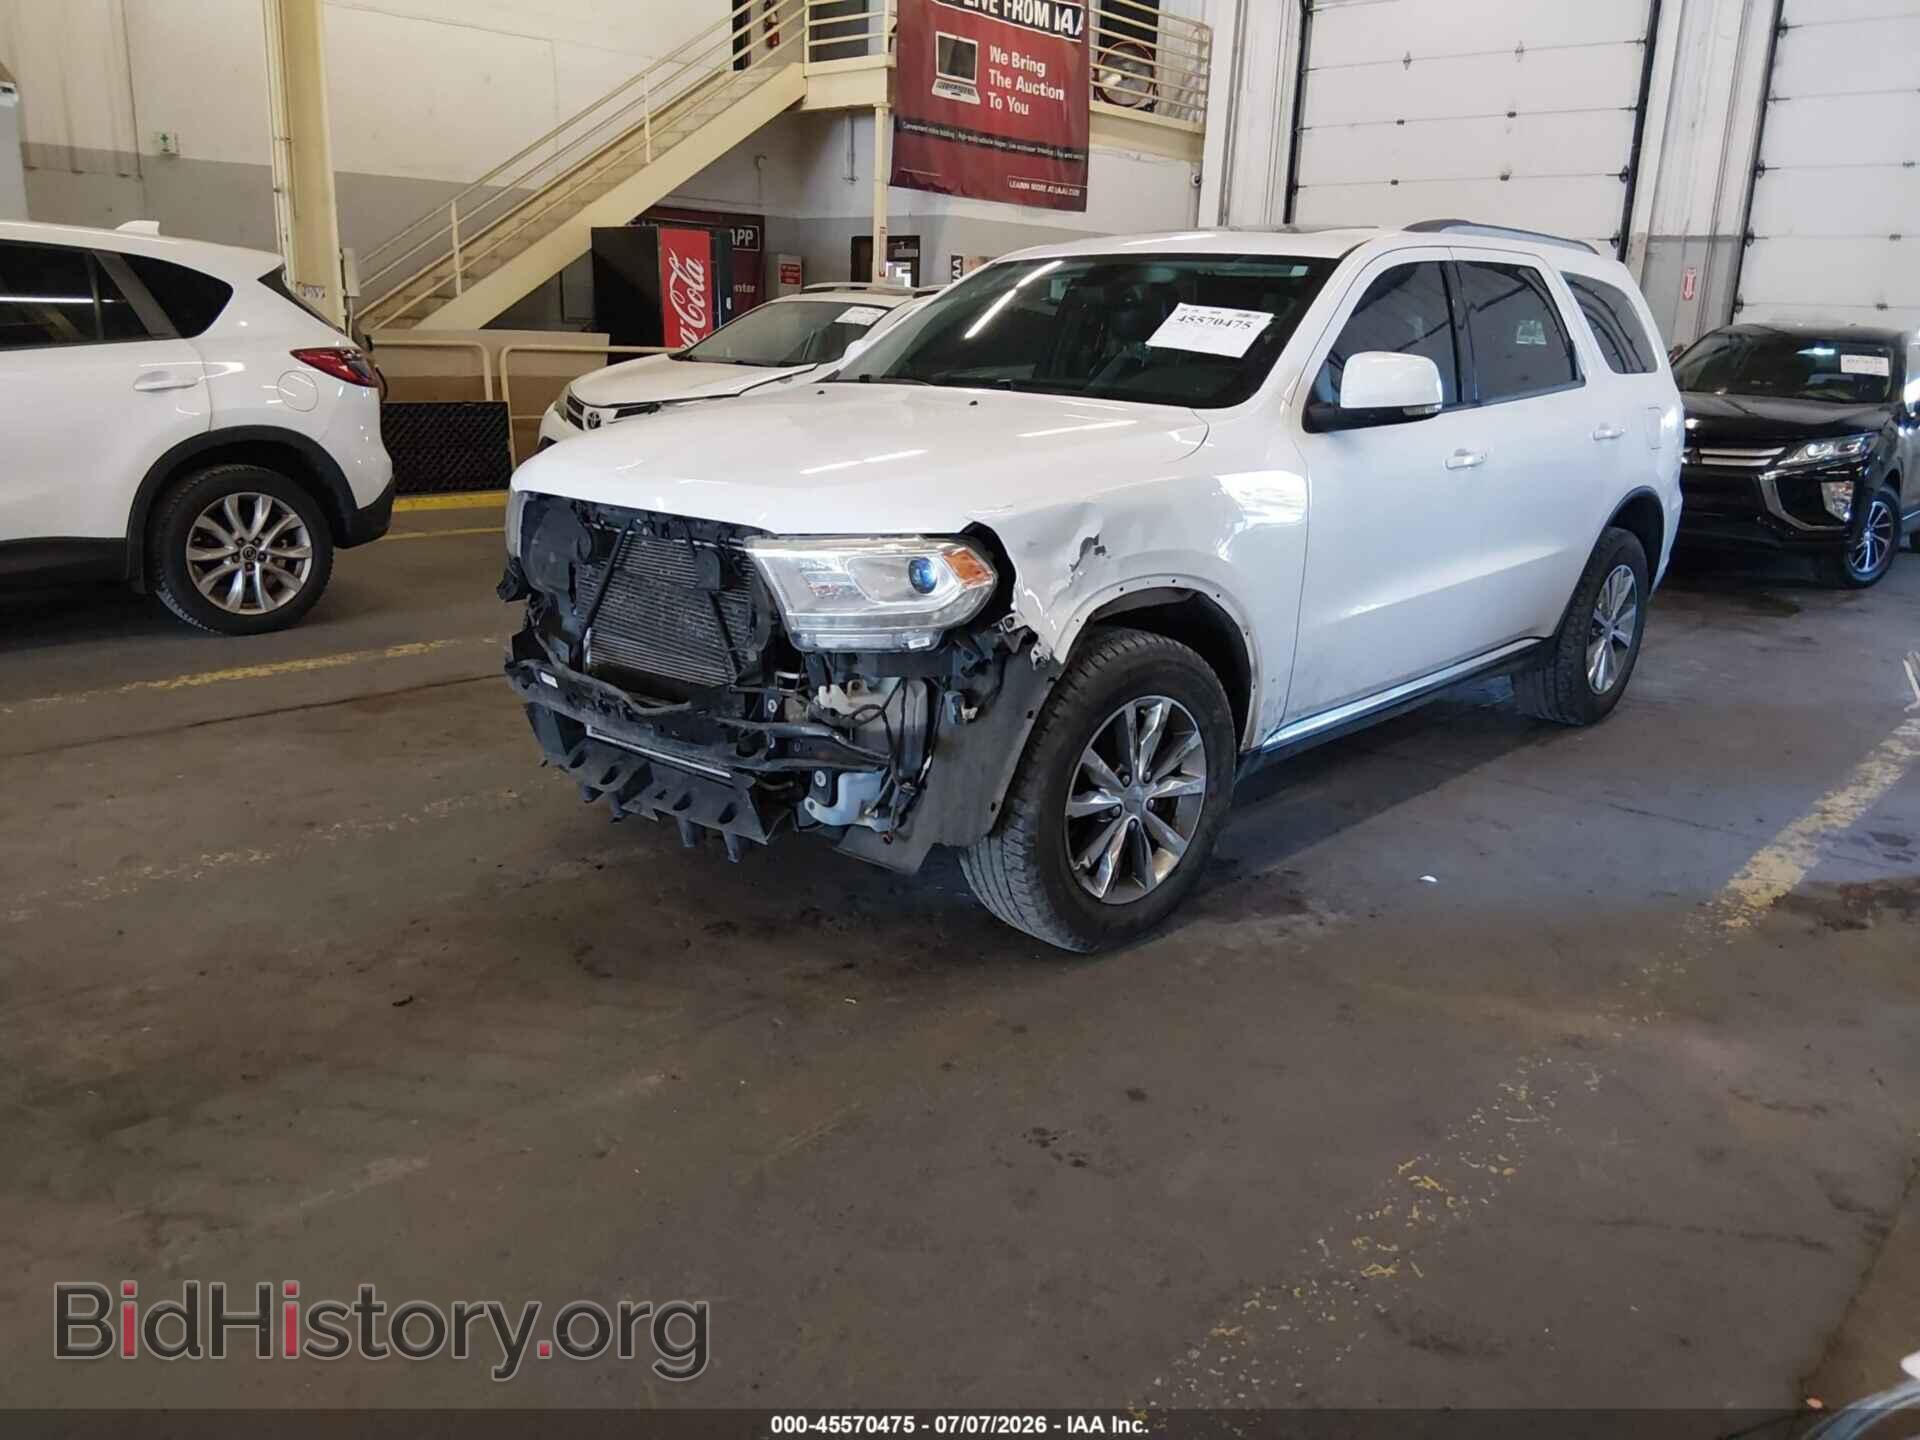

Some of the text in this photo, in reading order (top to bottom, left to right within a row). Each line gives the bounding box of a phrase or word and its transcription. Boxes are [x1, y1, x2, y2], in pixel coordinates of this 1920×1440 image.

[1004, 0, 1050, 28] FROM
[990, 45, 1046, 78] We Bring
[989, 68, 1065, 100] The Auction
[988, 91, 1029, 115] To You
[734, 283, 756, 294] nter
